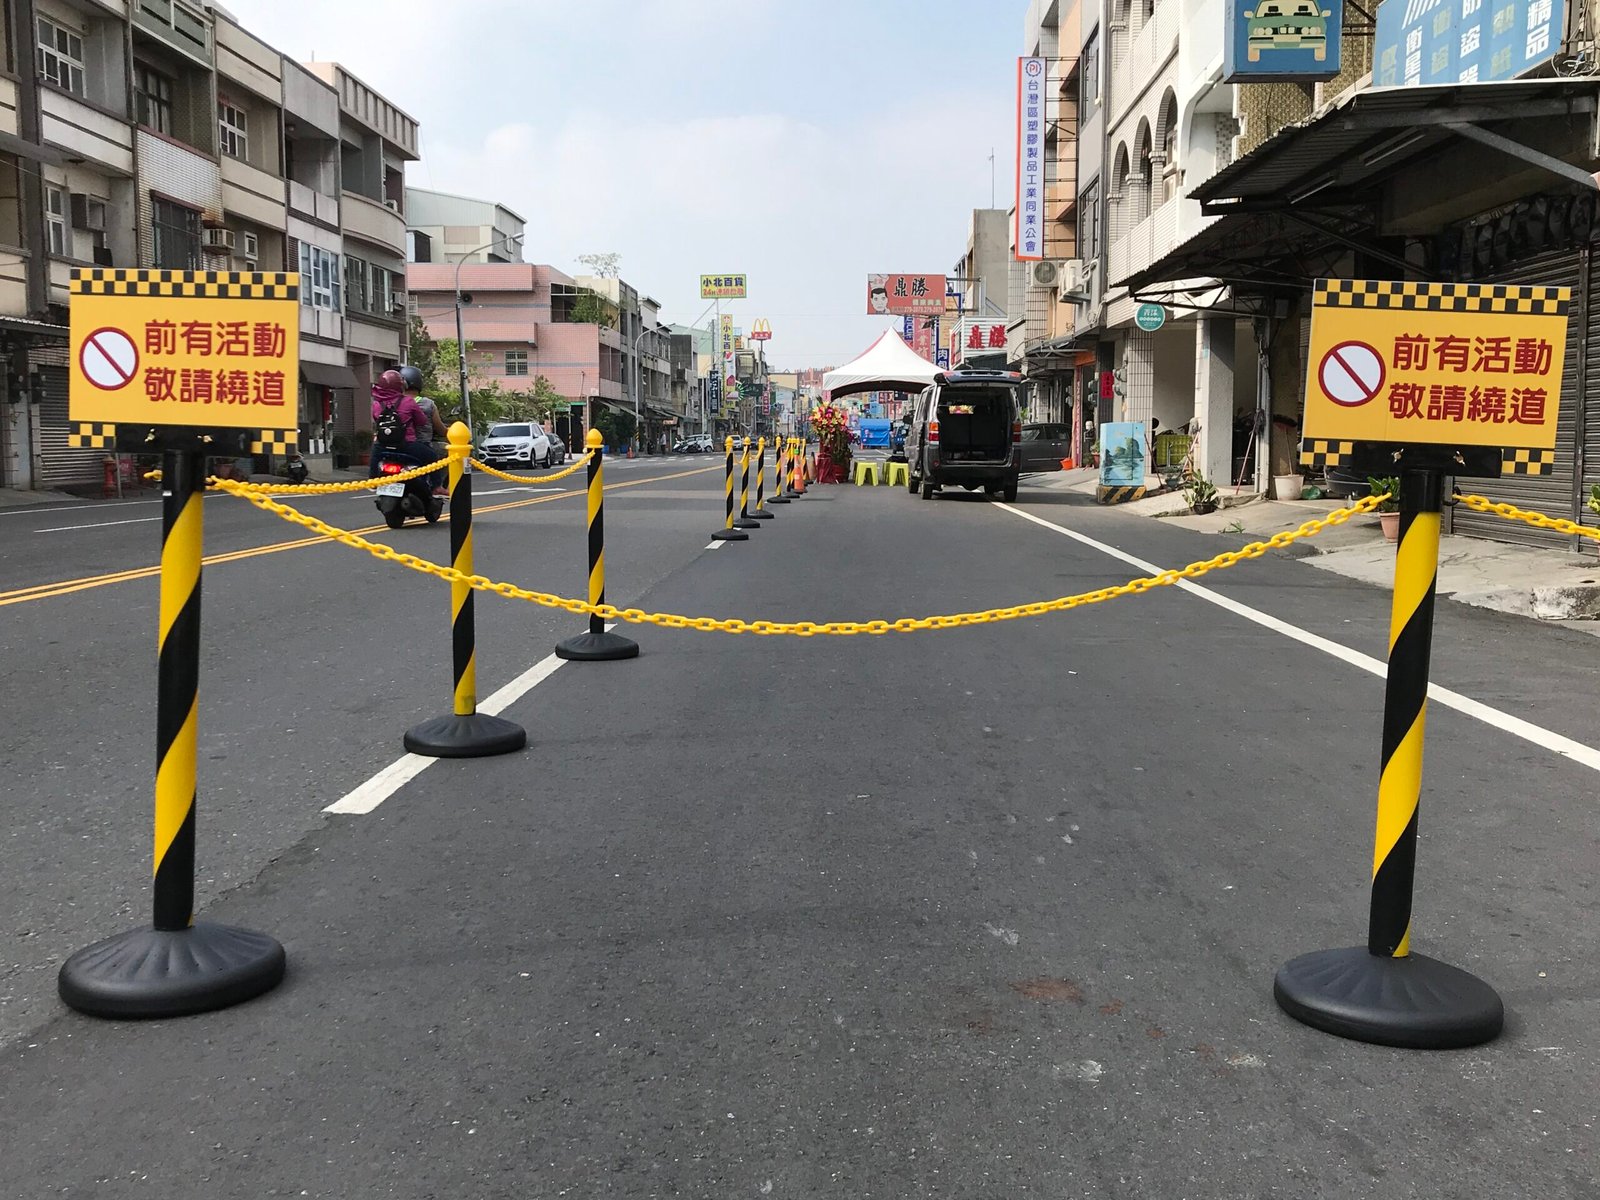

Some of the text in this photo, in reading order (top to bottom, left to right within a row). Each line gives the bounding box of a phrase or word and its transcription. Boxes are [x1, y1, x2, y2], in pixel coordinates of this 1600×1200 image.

[1025, 79, 1039, 252] 台灣區塑膠製品工業同業公會
[702, 277, 744, 287] 小北百貨
[893, 277, 930, 297] 鼎勝
[144, 318, 287, 359] 前有活動
[966, 324, 1008, 350] 鼎勝
[1392, 332, 1553, 376] 前有活動
[143, 366, 286, 407] 敬請繞道
[1387, 382, 1548, 426] 敬請繞道
